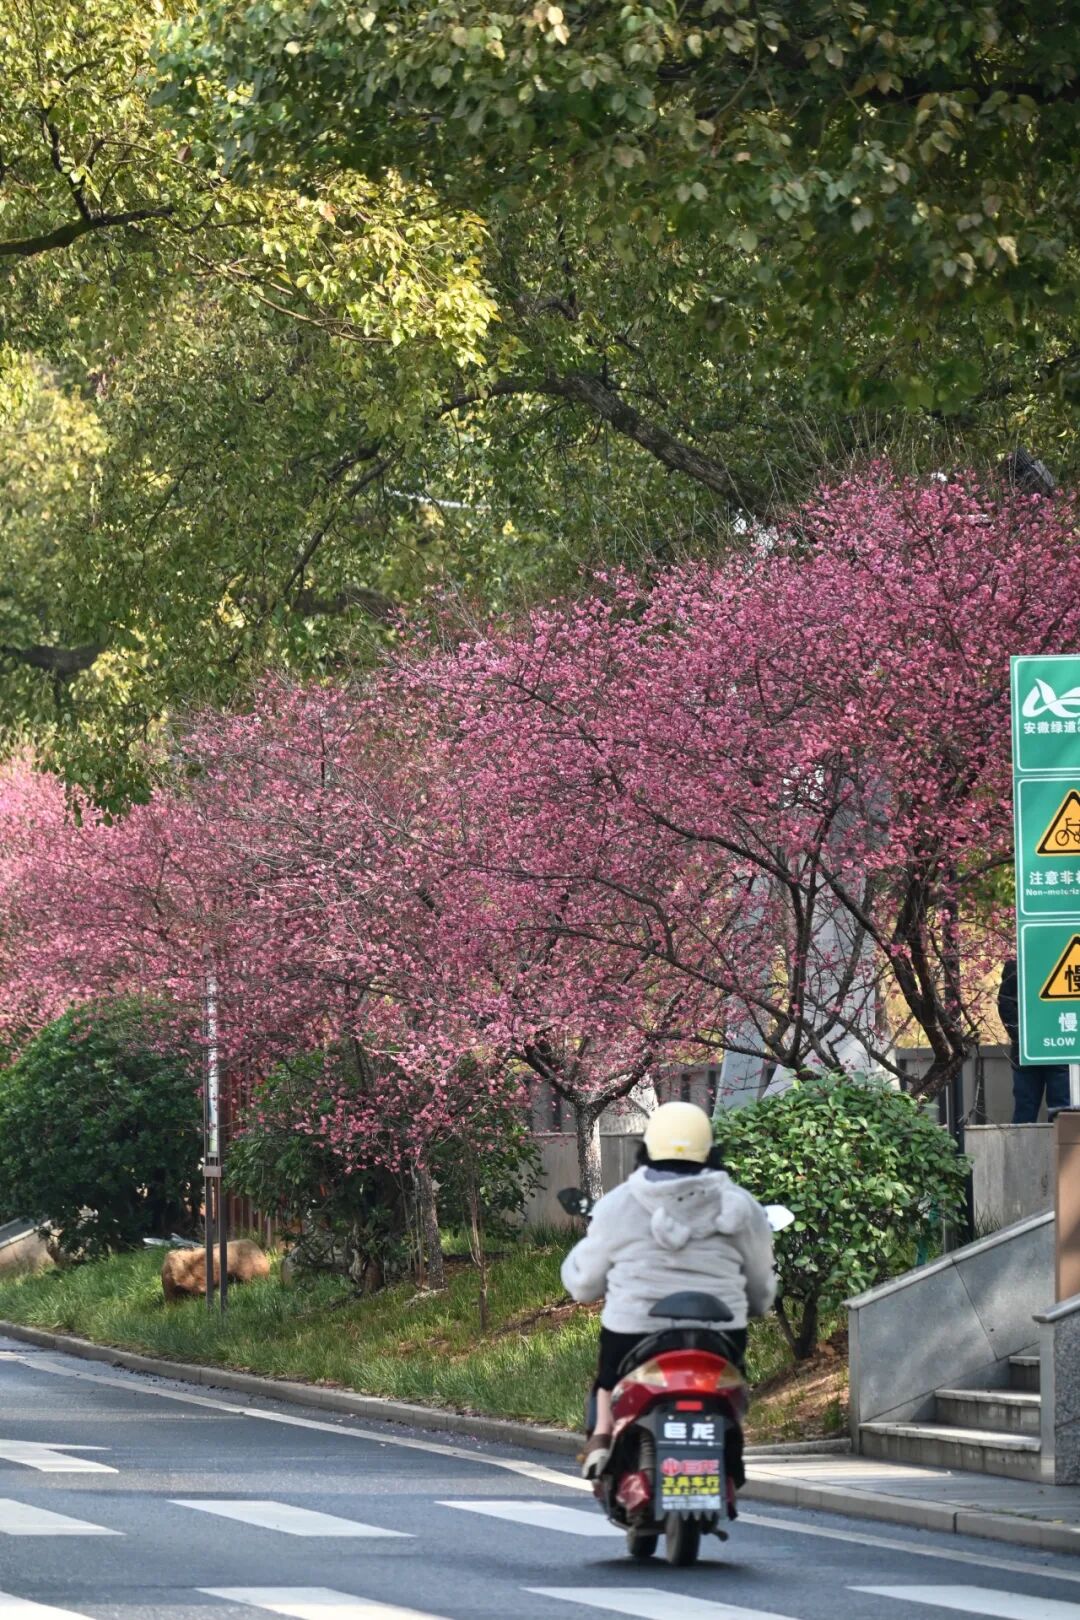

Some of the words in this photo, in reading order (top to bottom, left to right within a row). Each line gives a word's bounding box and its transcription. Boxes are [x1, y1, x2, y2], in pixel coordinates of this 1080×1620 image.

[1023, 720, 1080, 735] 安徽绿道
[1058, 1012, 1078, 1032] 慢
[1043, 1037, 1075, 1047] SLOW
[664, 1422, 715, 1440] 巨龙
